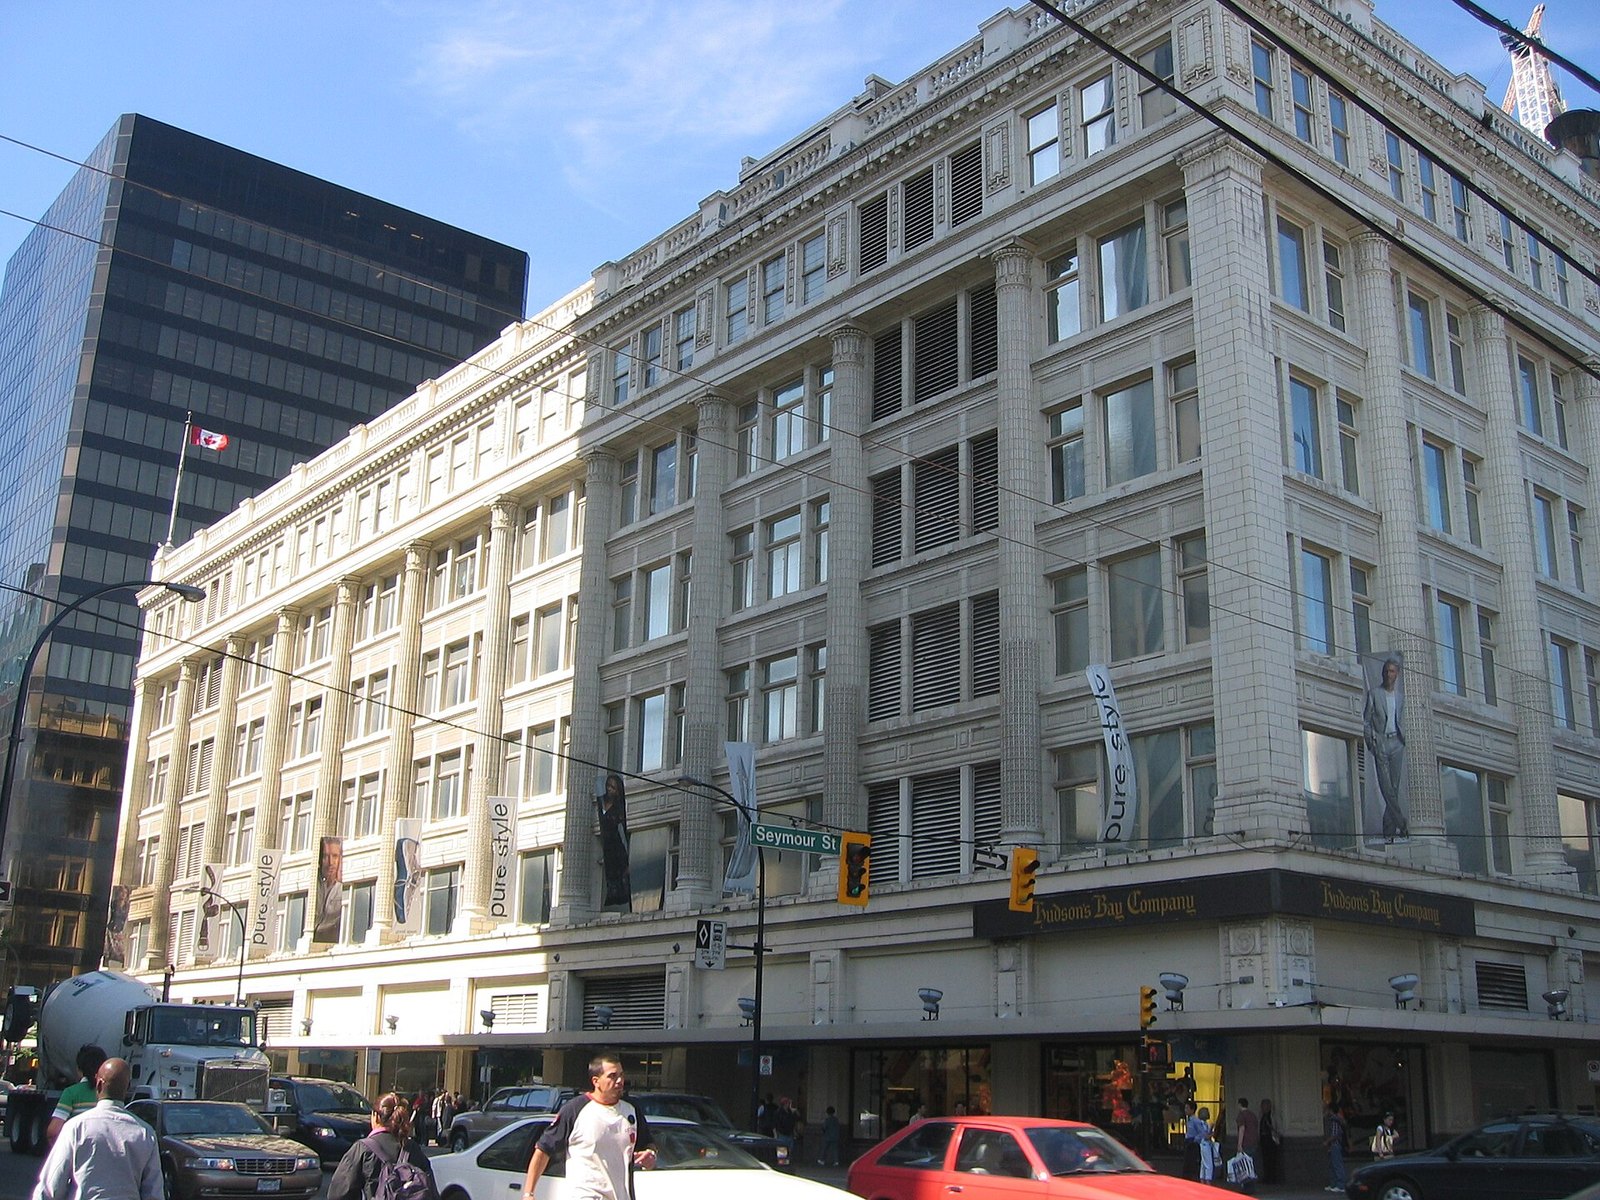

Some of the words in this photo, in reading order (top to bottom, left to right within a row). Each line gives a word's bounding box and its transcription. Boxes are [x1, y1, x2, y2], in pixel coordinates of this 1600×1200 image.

[1104, 764, 1126, 842] pure
[492, 804, 512, 857] style
[756, 826, 816, 846] Seymour
[821, 835, 836, 850] St
[257, 854, 275, 897] style
[491, 865, 508, 917] pure
[253, 903, 268, 945] pure
[1033, 899, 1092, 928] Hudson's
[1093, 894, 1125, 922] Bay
[1127, 890, 1196, 917] Company
[1368, 888, 1393, 921] Bay
[1395, 892, 1440, 928] Company
